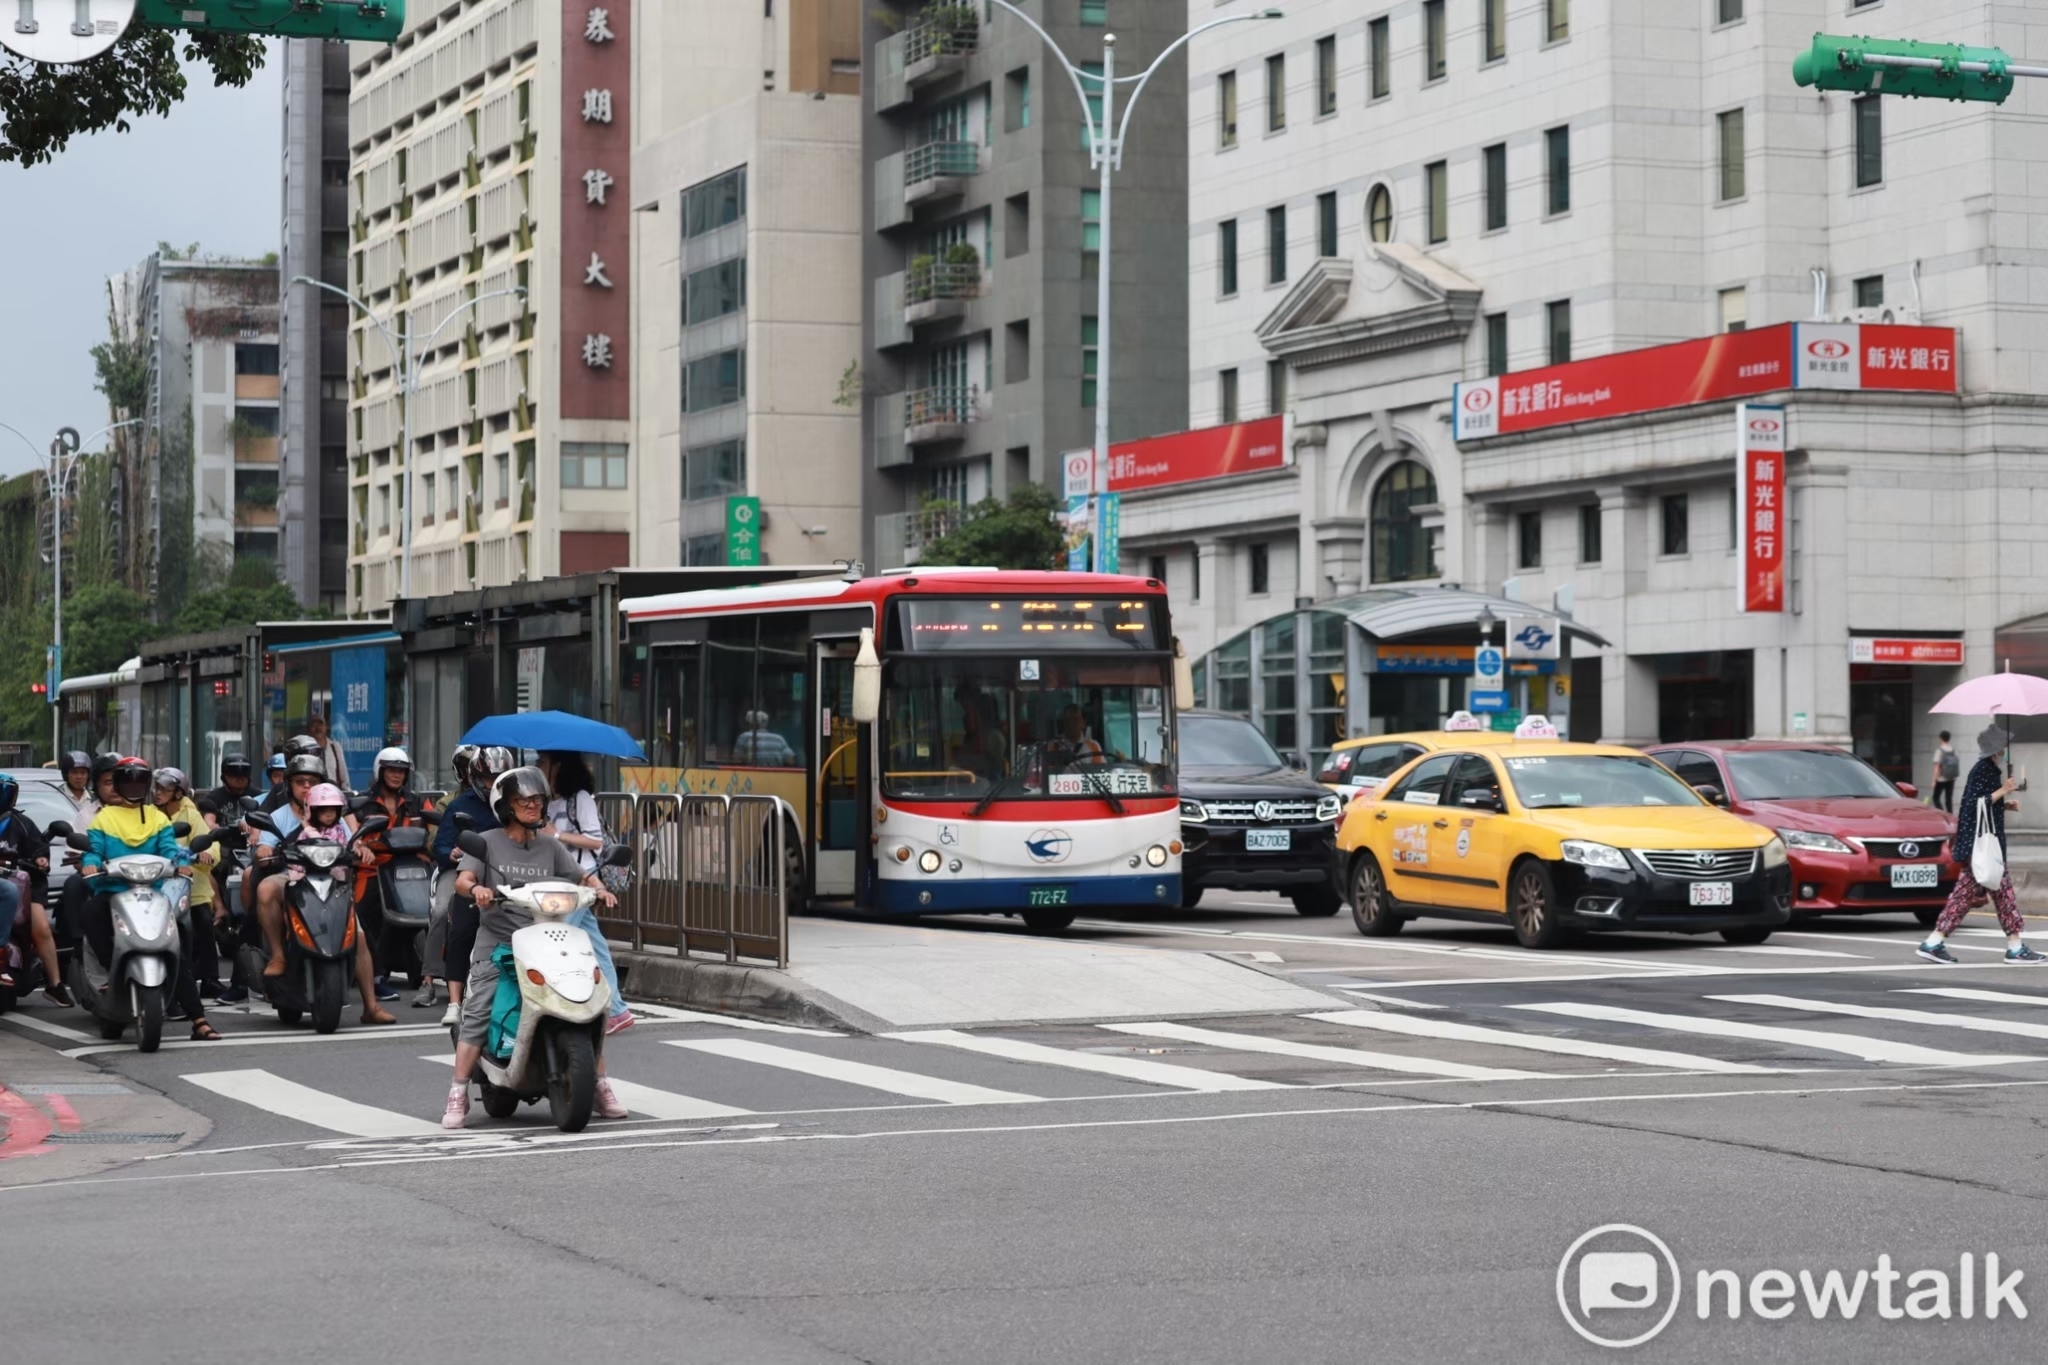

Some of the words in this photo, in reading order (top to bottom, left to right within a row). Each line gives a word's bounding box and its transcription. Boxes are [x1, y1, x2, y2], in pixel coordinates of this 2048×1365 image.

[582, 8, 615, 368] 券期貨大樓
[1808, 360, 1850, 373] 新光金控
[1867, 347, 1950, 371] 新光銀行
[1503, 380, 1562, 417] 新光銀行
[1754, 459, 1775, 559] 新光銀行
[1555, 681, 1565, 696] 6
[1054, 780, 1080, 793] 280
[1117, 774, 1148, 794] 行天宮
[1247, 834, 1289, 847] BAZ-7005
[1893, 870, 1937, 885] AKX-0898
[1030, 890, 1067, 905] 772-FZ
[1692, 887, 1731, 902] 763-7C
